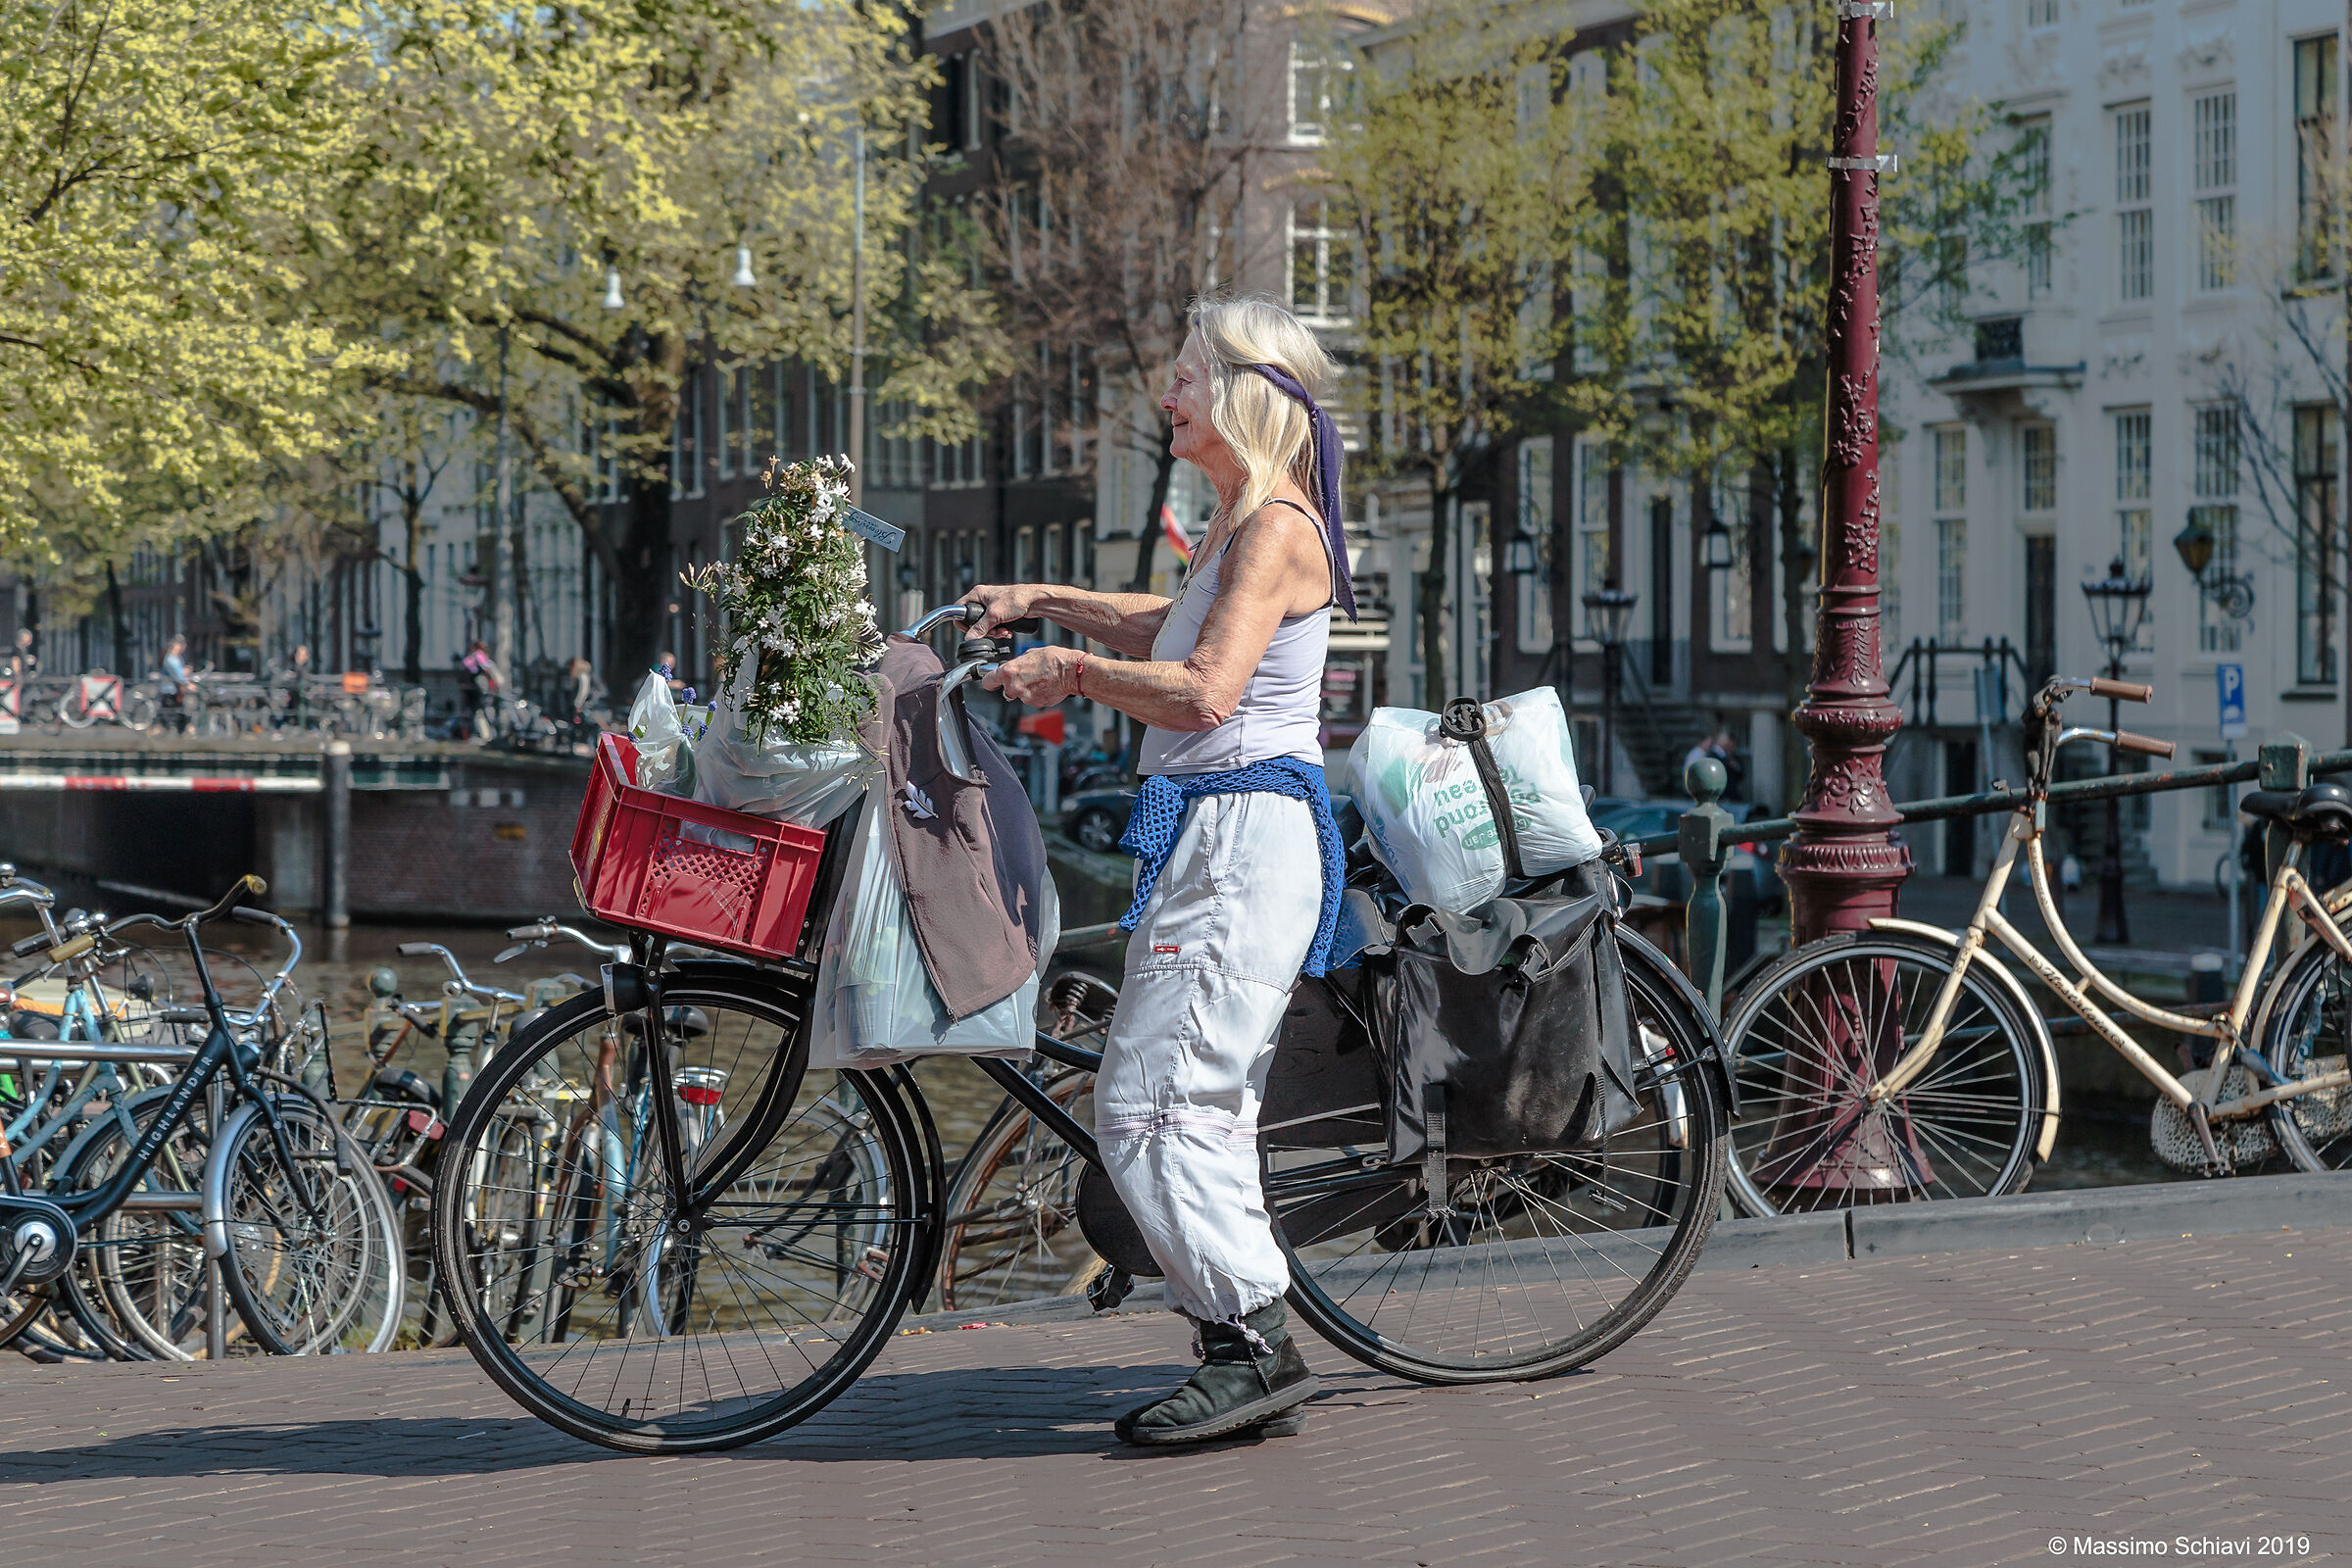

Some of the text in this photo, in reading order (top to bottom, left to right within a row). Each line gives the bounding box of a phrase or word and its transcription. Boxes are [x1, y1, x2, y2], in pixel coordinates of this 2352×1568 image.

[2225, 667, 2240, 701] P
[1434, 764, 1524, 807] Teeau
[1434, 782, 1542, 839] Porond
[1464, 833, 1485, 847] Jan
[137, 1056, 214, 1160] HIGHLANDER
